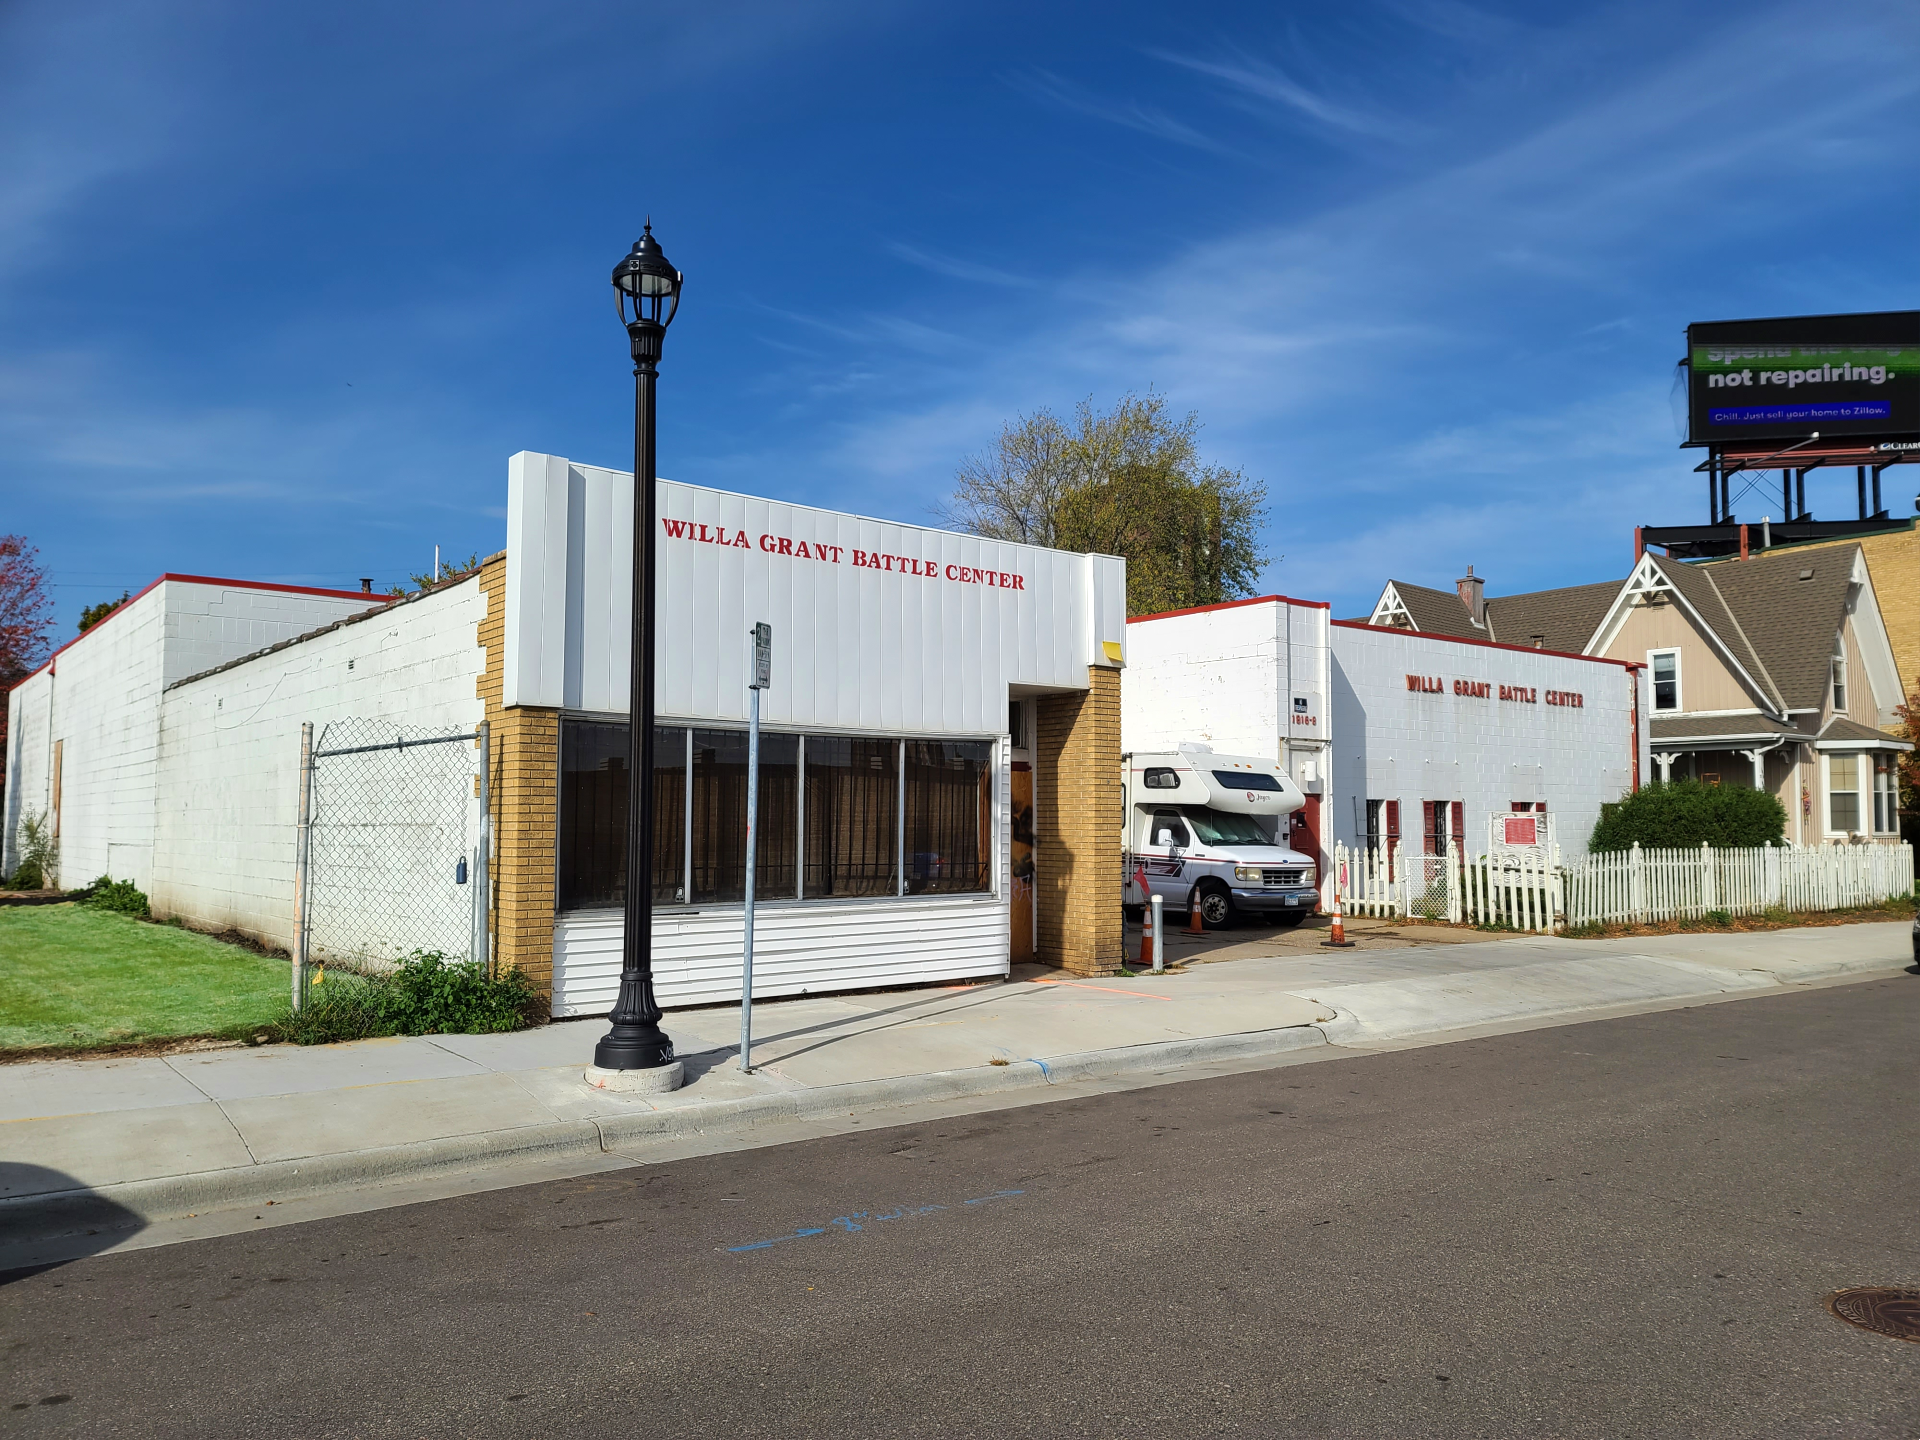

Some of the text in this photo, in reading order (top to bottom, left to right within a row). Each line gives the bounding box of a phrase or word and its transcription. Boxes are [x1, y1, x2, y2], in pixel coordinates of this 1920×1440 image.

[1709, 362, 1895, 388] not repairing.
[1715, 412, 1741, 421] Chill.
[1743, 412, 1765, 420] Just
[1786, 411, 1809, 419] your
[1811, 409, 1838, 417] home
[1854, 407, 1886, 415] Zillow.
[662, 518, 1025, 591] WILLA GRANT BATTLE CENTER
[1405, 674, 1584, 708] WILLA GRANT BATTLE CENTER
